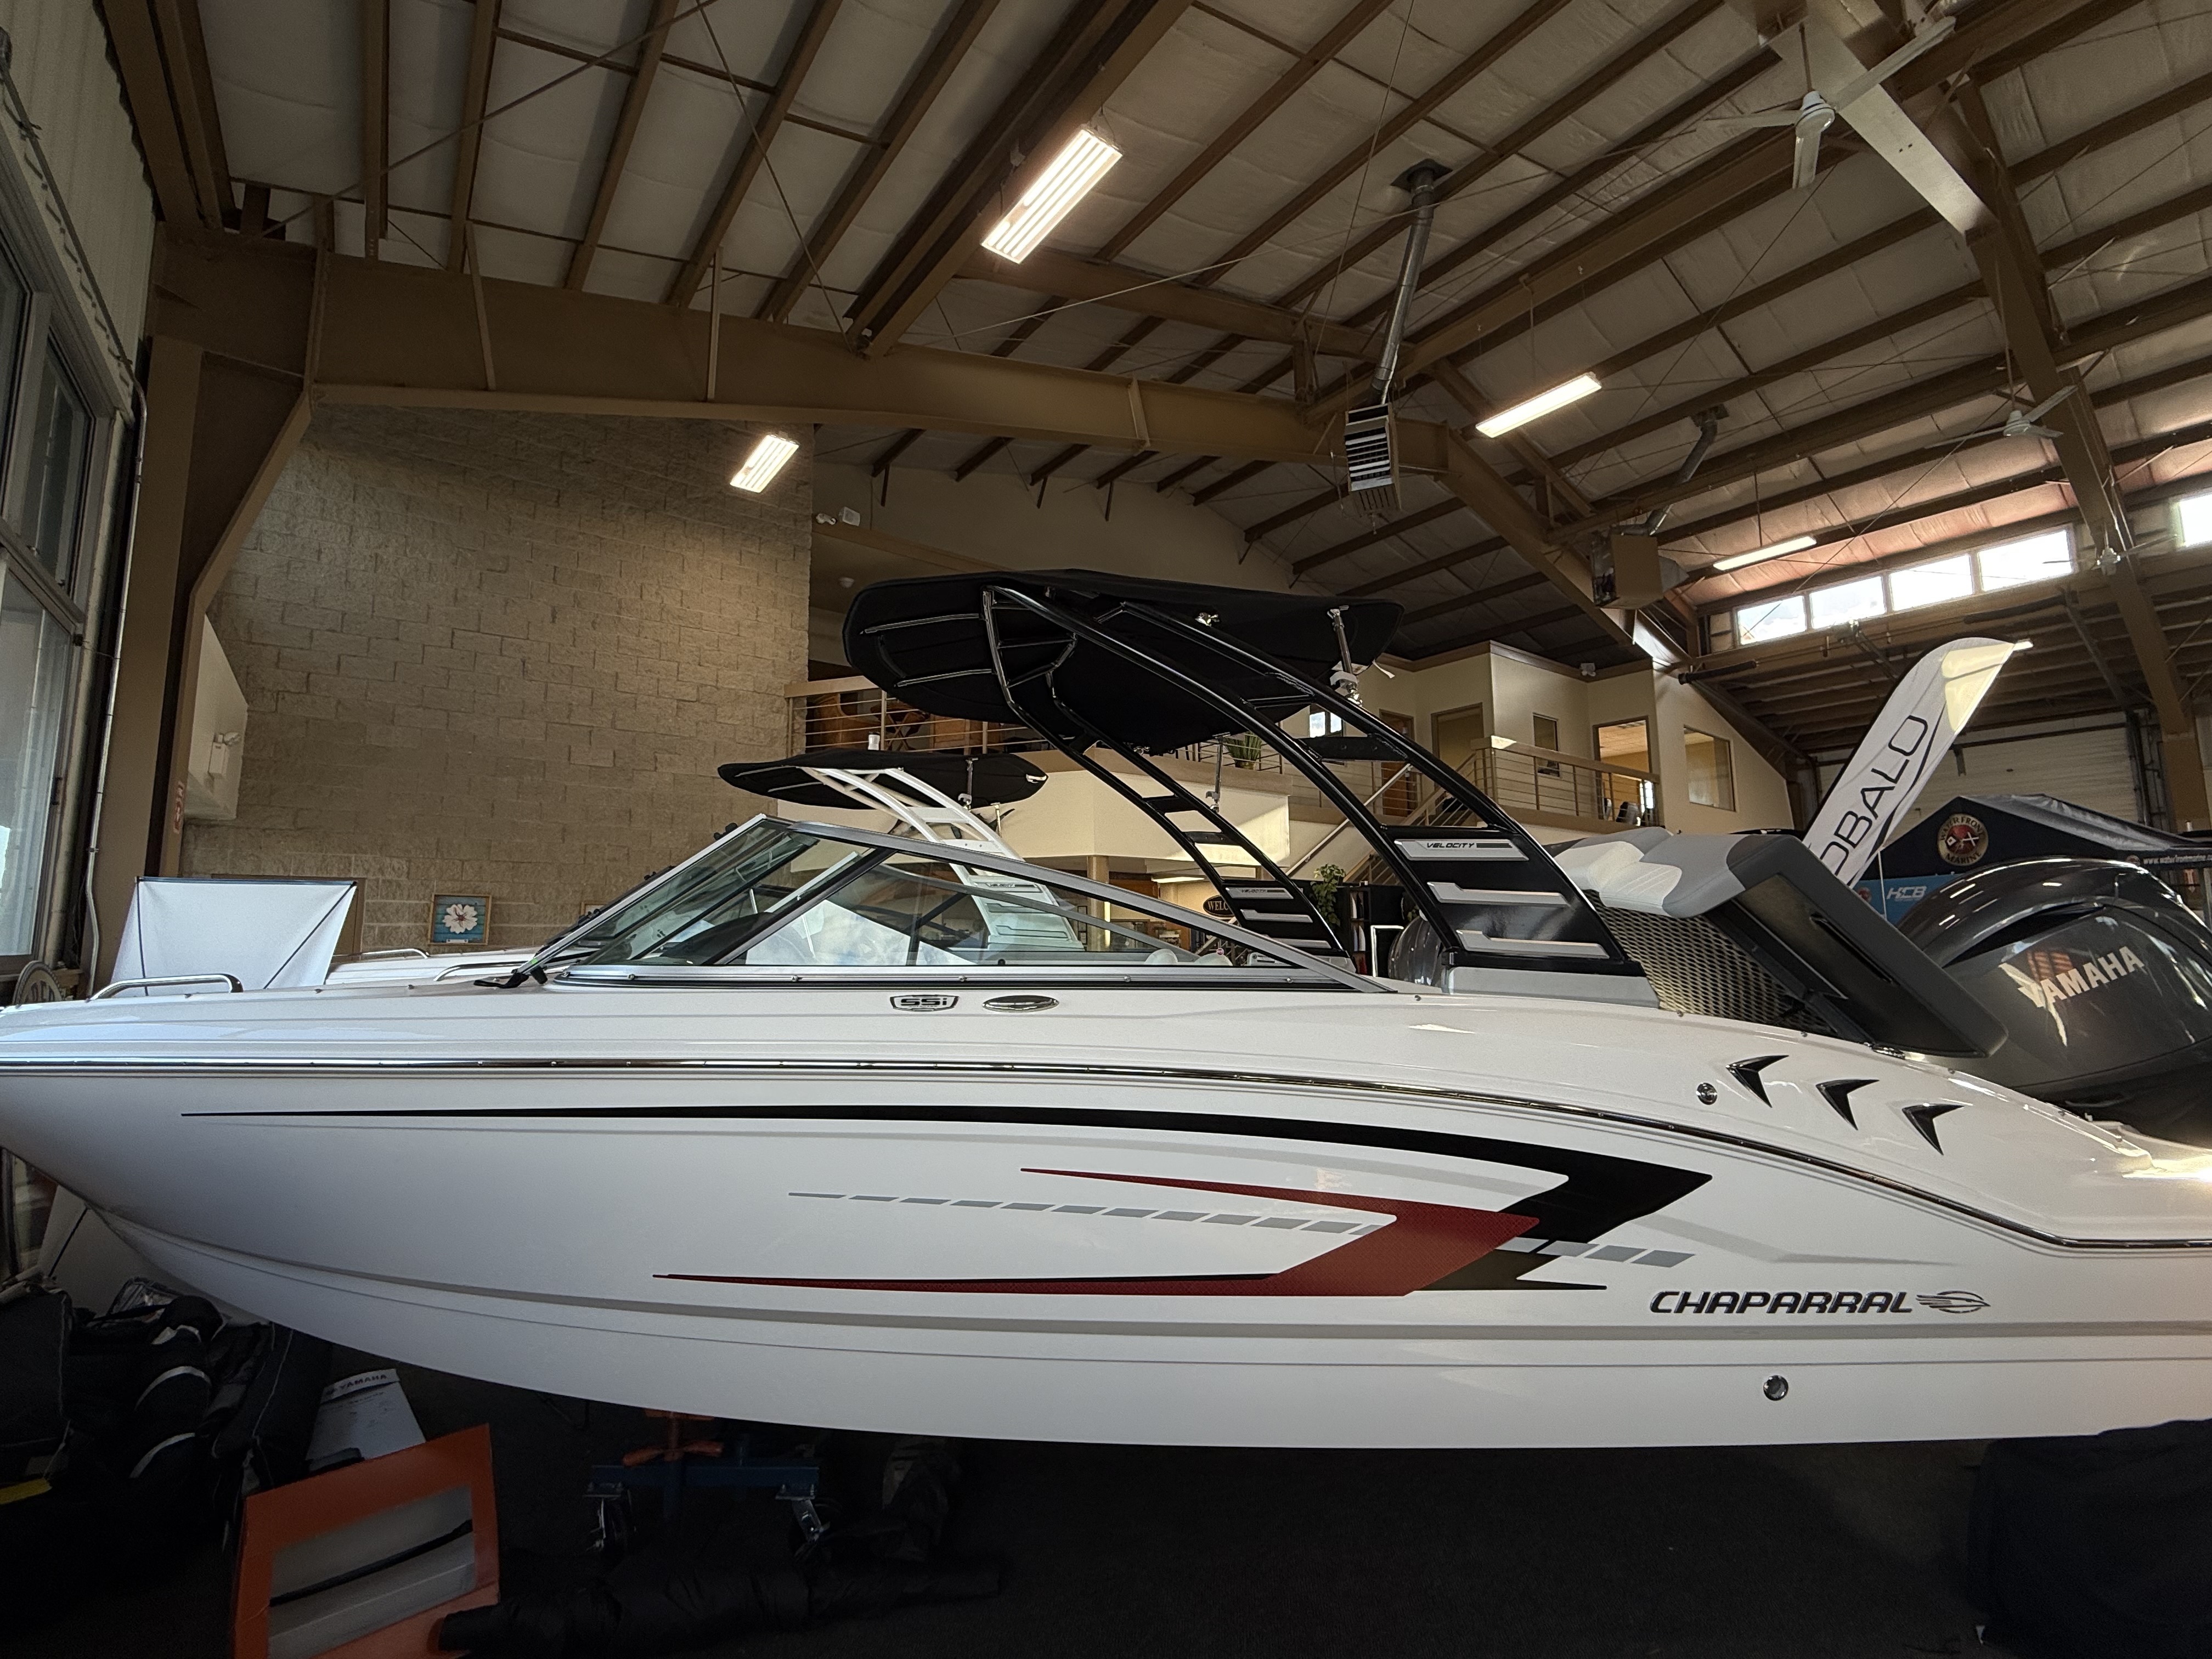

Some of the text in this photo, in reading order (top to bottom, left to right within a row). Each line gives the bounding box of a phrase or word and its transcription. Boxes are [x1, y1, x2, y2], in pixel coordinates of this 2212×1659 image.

[1809, 715, 1928, 876] OBALO
[1946, 853, 1982, 864] MARINE
[1886, 886, 1927, 900] HCB
[1207, 900, 1230, 911] WELC
[2018, 946, 2144, 1008] YAMAHA
[1650, 1291, 1912, 1313] CHAPARRAL
[339, 1374, 387, 1391] YAMAHA
